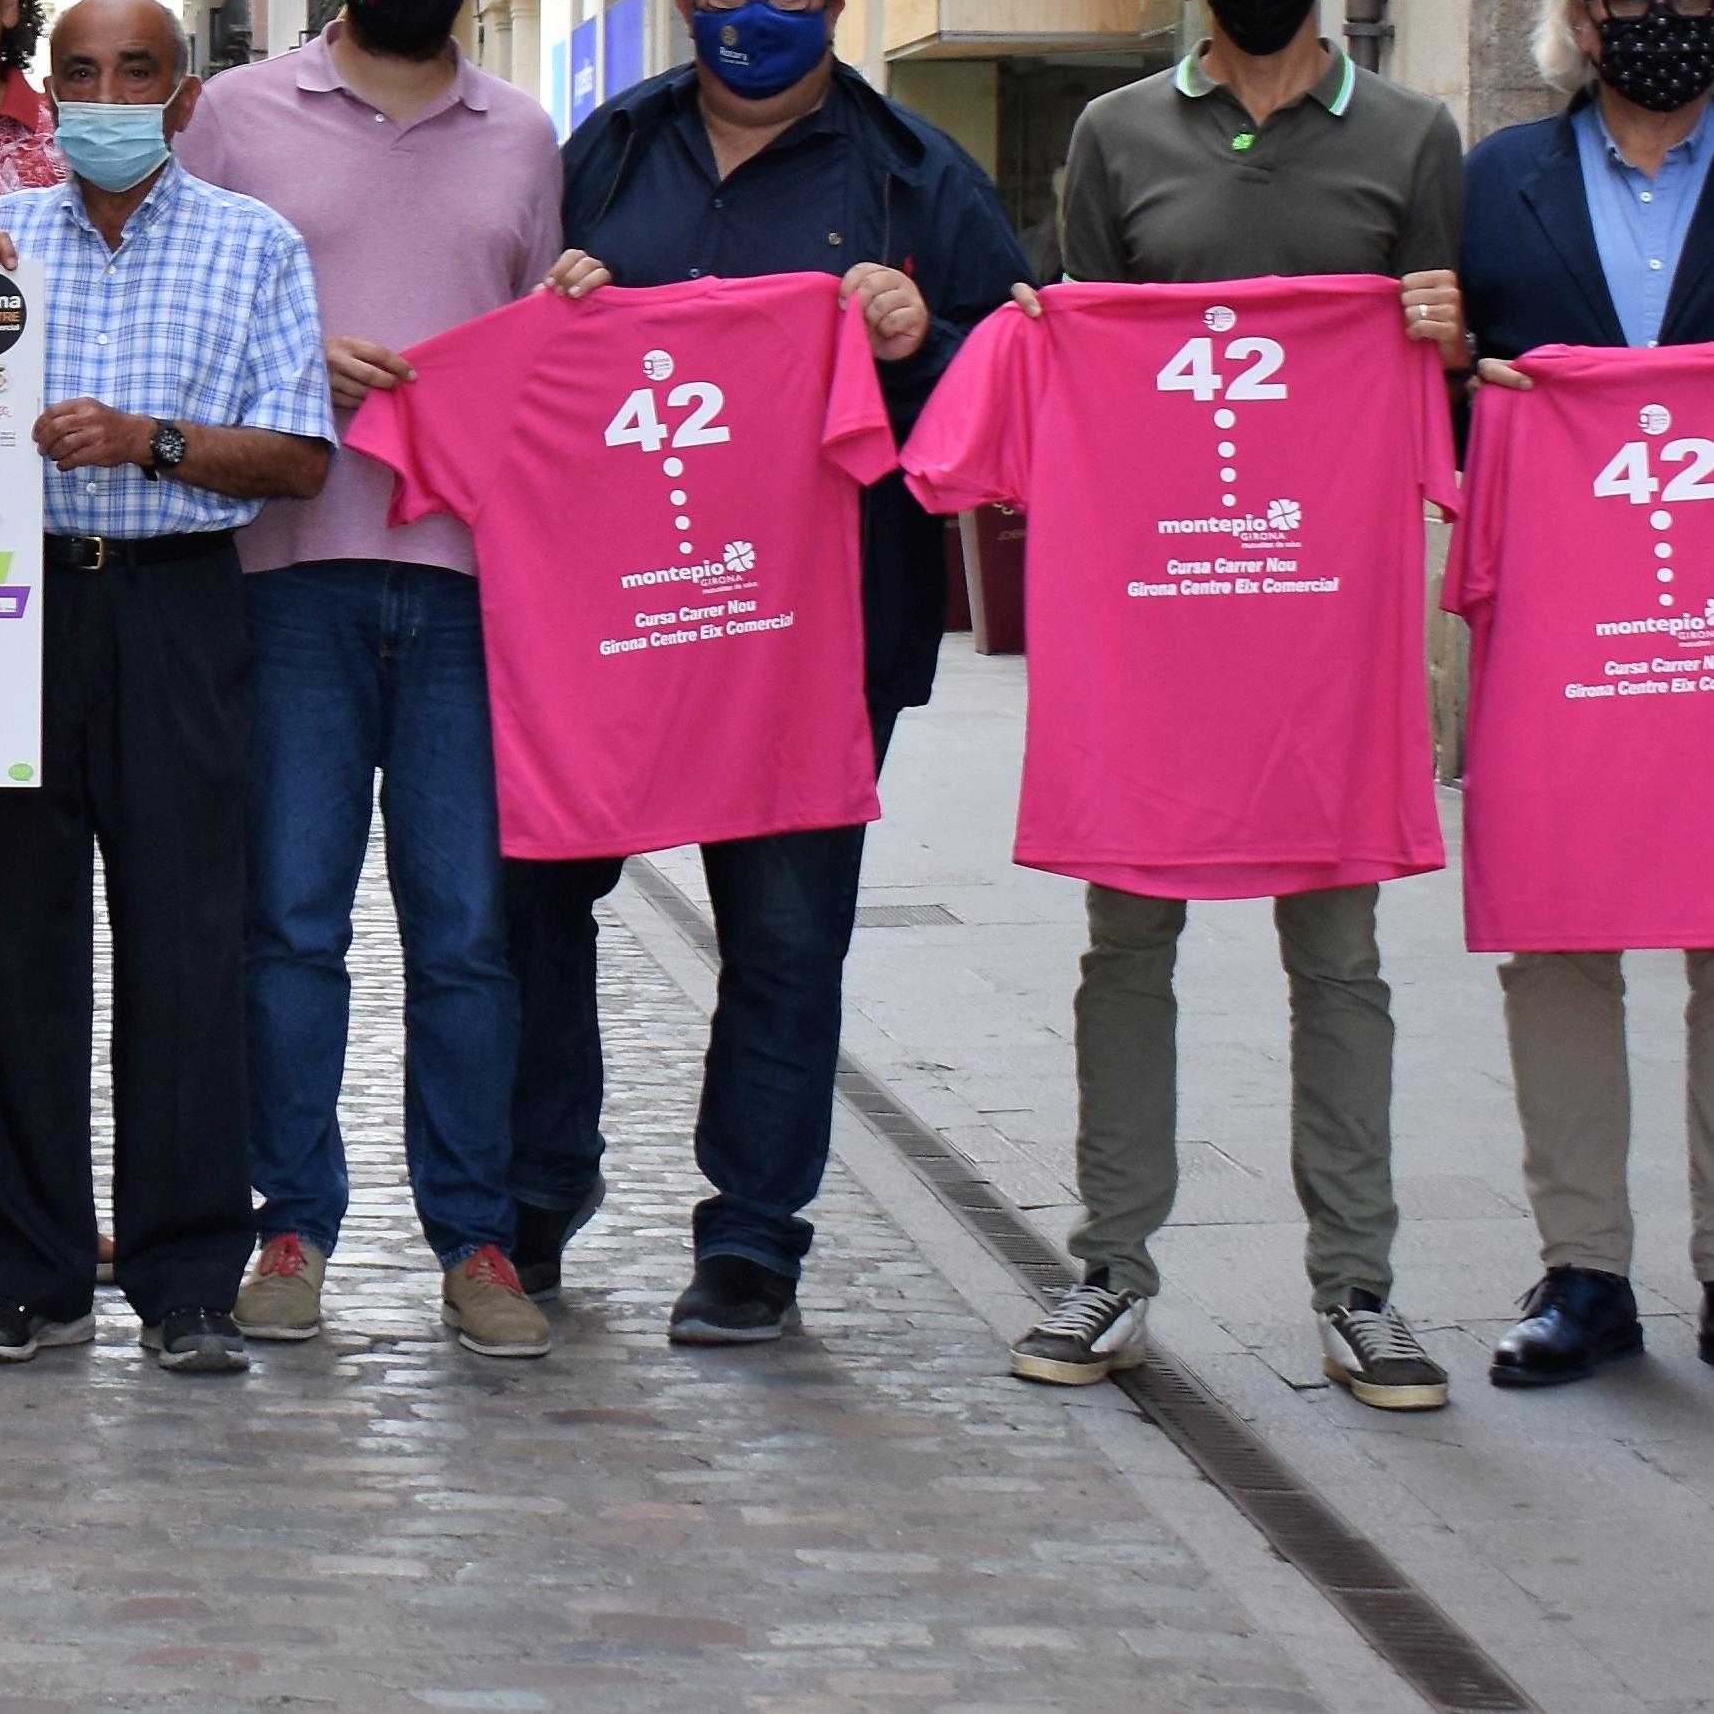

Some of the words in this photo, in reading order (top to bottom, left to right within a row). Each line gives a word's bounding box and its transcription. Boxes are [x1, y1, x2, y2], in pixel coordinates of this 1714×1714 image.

[1156, 336, 1288, 401] 42
[603, 381, 731, 452] 42
[1592, 438, 1714, 505] 42
[1157, 513, 1267, 536] montepio
[1240, 532, 1286, 541] GIRONA
[621, 560, 725, 589] montepio
[1166, 559, 1211, 575] Cursa
[1214, 557, 1263, 573] Carrer
[1265, 557, 1297, 572] Nou
[1127, 581, 1178, 597] Girona
[1180, 579, 1232, 596] Centre
[1235, 577, 1259, 594] Eix
[1262, 577, 1340, 593] Comercial
[635, 611, 677, 628] Cursa
[679, 604, 726, 622] Carrer
[727, 599, 757, 614] Nou
[1595, 612, 1705, 637] montepio
[599, 637, 648, 656] Girona
[650, 629, 697, 647] Centre
[700, 624, 724, 640] Eix
[725, 610, 795, 635] Comercial
[1677, 630, 1714, 640] GIRON
[1604, 660, 1650, 676] Cursa
[1651, 657, 1702, 673] Carrer
[1564, 683, 1616, 699] Girona
[1617, 680, 1669, 696] Centre
[1670, 677, 1697, 693] Eix
